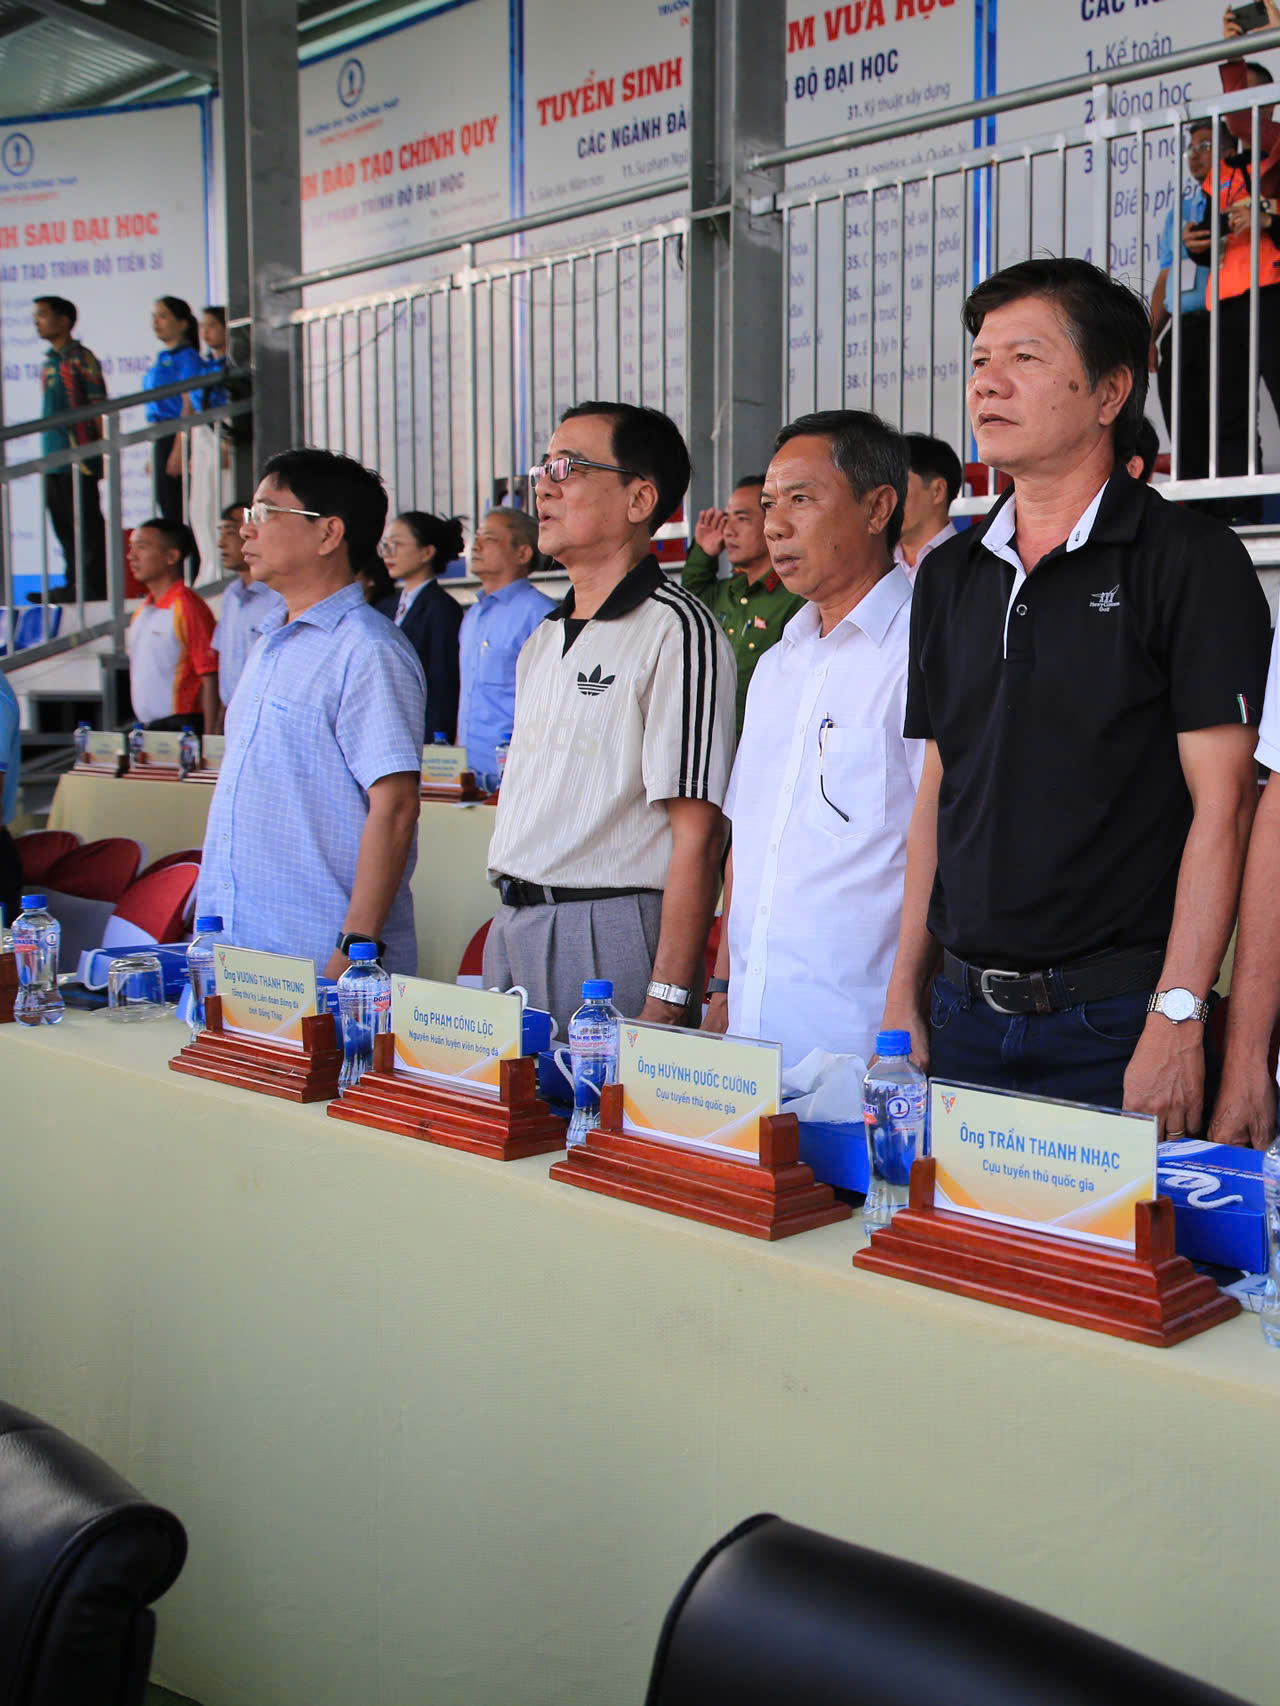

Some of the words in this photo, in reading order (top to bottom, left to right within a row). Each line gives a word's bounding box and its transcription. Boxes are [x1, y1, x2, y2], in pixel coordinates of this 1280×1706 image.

[1132, 32, 1172, 62] toán
[825, 60, 854, 93] ĐẠI
[861, 48, 899, 83] HỌC
[536, 69, 615, 126] TUYỂN
[621, 56, 684, 103] SINH
[459, 114, 499, 156] QUY
[611, 115, 662, 150] NGÀNH
[24, 220, 67, 247] SAU
[453, 1014, 476, 1034] CÔNG
[638, 1055, 656, 1079] Ông
[658, 1062, 691, 1083] HUỲNH
[693, 1068, 720, 1089] QUỐC
[722, 1074, 757, 1097] CƯỜNG
[724, 1103, 736, 1115] gia
[959, 1122, 985, 1149] Ông
[988, 1127, 1026, 1154] TRẦN
[1029, 1137, 1078, 1163] THANH
[1080, 1146, 1121, 1173] NHẠC
[982, 1159, 1001, 1175] Cựu
[1032, 1168, 1049, 1184] thủ
[1051, 1173, 1076, 1189] quốc
[1079, 1178, 1095, 1193] gia
